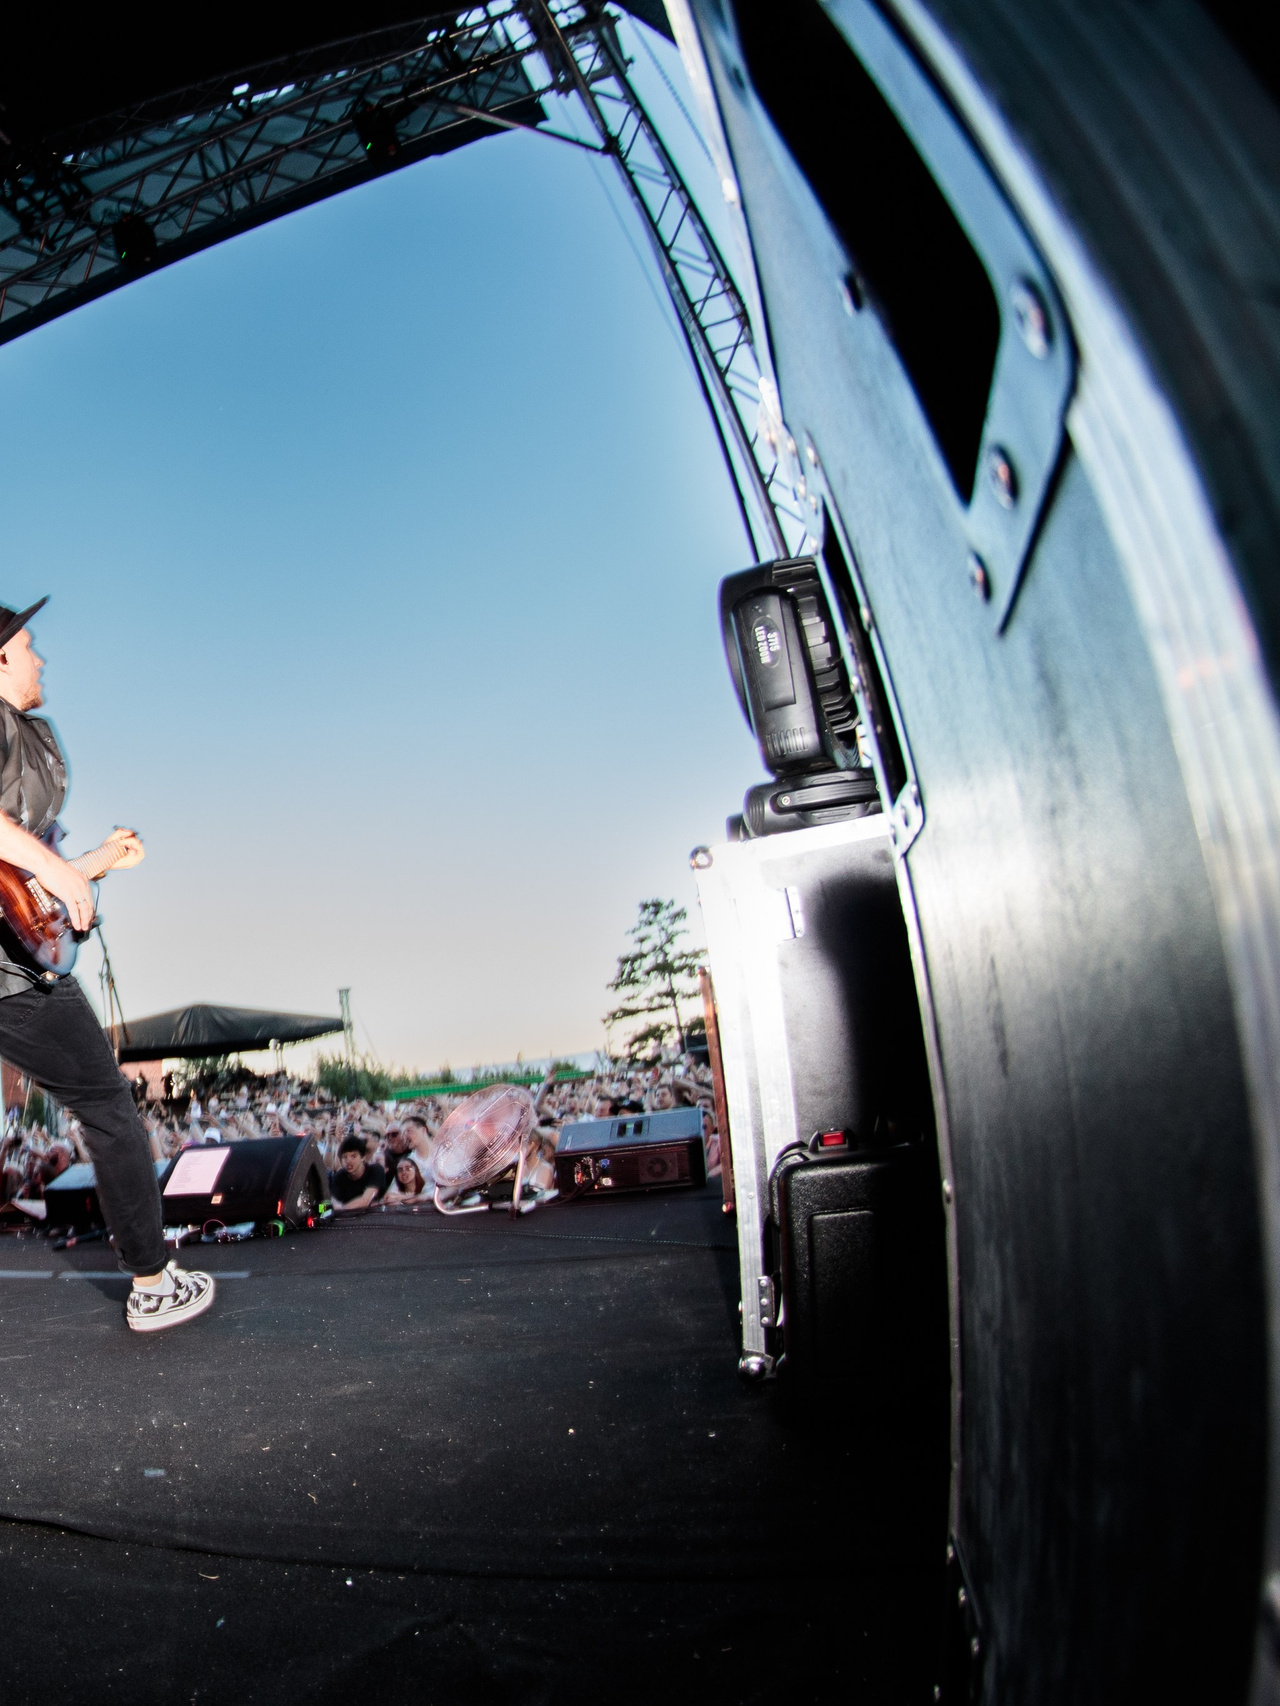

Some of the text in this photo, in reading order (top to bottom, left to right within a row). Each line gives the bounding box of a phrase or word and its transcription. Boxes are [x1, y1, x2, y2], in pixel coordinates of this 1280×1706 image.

[755, 625, 771, 663] LED ZOOM
[767, 631, 781, 651] 3715
